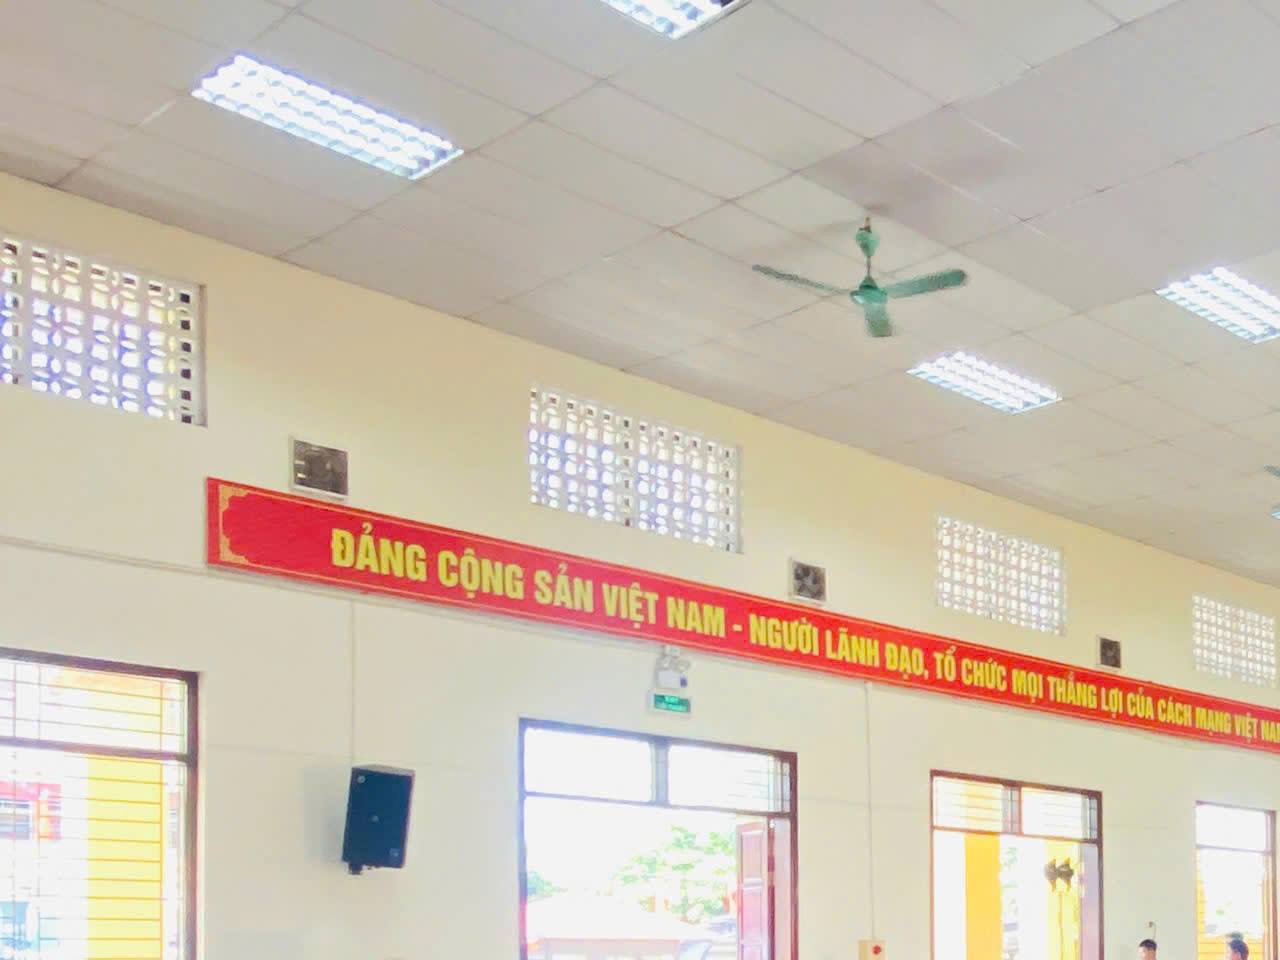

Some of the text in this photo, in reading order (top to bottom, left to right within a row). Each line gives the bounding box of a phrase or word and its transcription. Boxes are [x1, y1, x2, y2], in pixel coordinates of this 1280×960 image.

[331, 522, 427, 582] ĐẢNG
[437, 547, 524, 599] CỘNG
[534, 563, 594, 613] SẢN
[602, 582, 659, 629] VIỆT
[666, 596, 726, 638] NAM
[749, 613, 820, 657] NGƯỜI
[824, 627, 881, 668] LÃNH
[884, 641, 930, 680] ĐẠO,
[933, 645, 957, 682] TỔ
[960, 657, 1008, 692] CHỨC
[1011, 668, 1044, 704] MỌI
[1047, 671, 1098, 709] THẮNG
[1101, 687, 1124, 719] LỢI
[1126, 687, 1155, 721] CỦA
[1157, 696, 1193, 727] CÁCH
[1195, 706, 1233, 737] MẠNG
[1234, 712, 1258, 744] VIỆT
